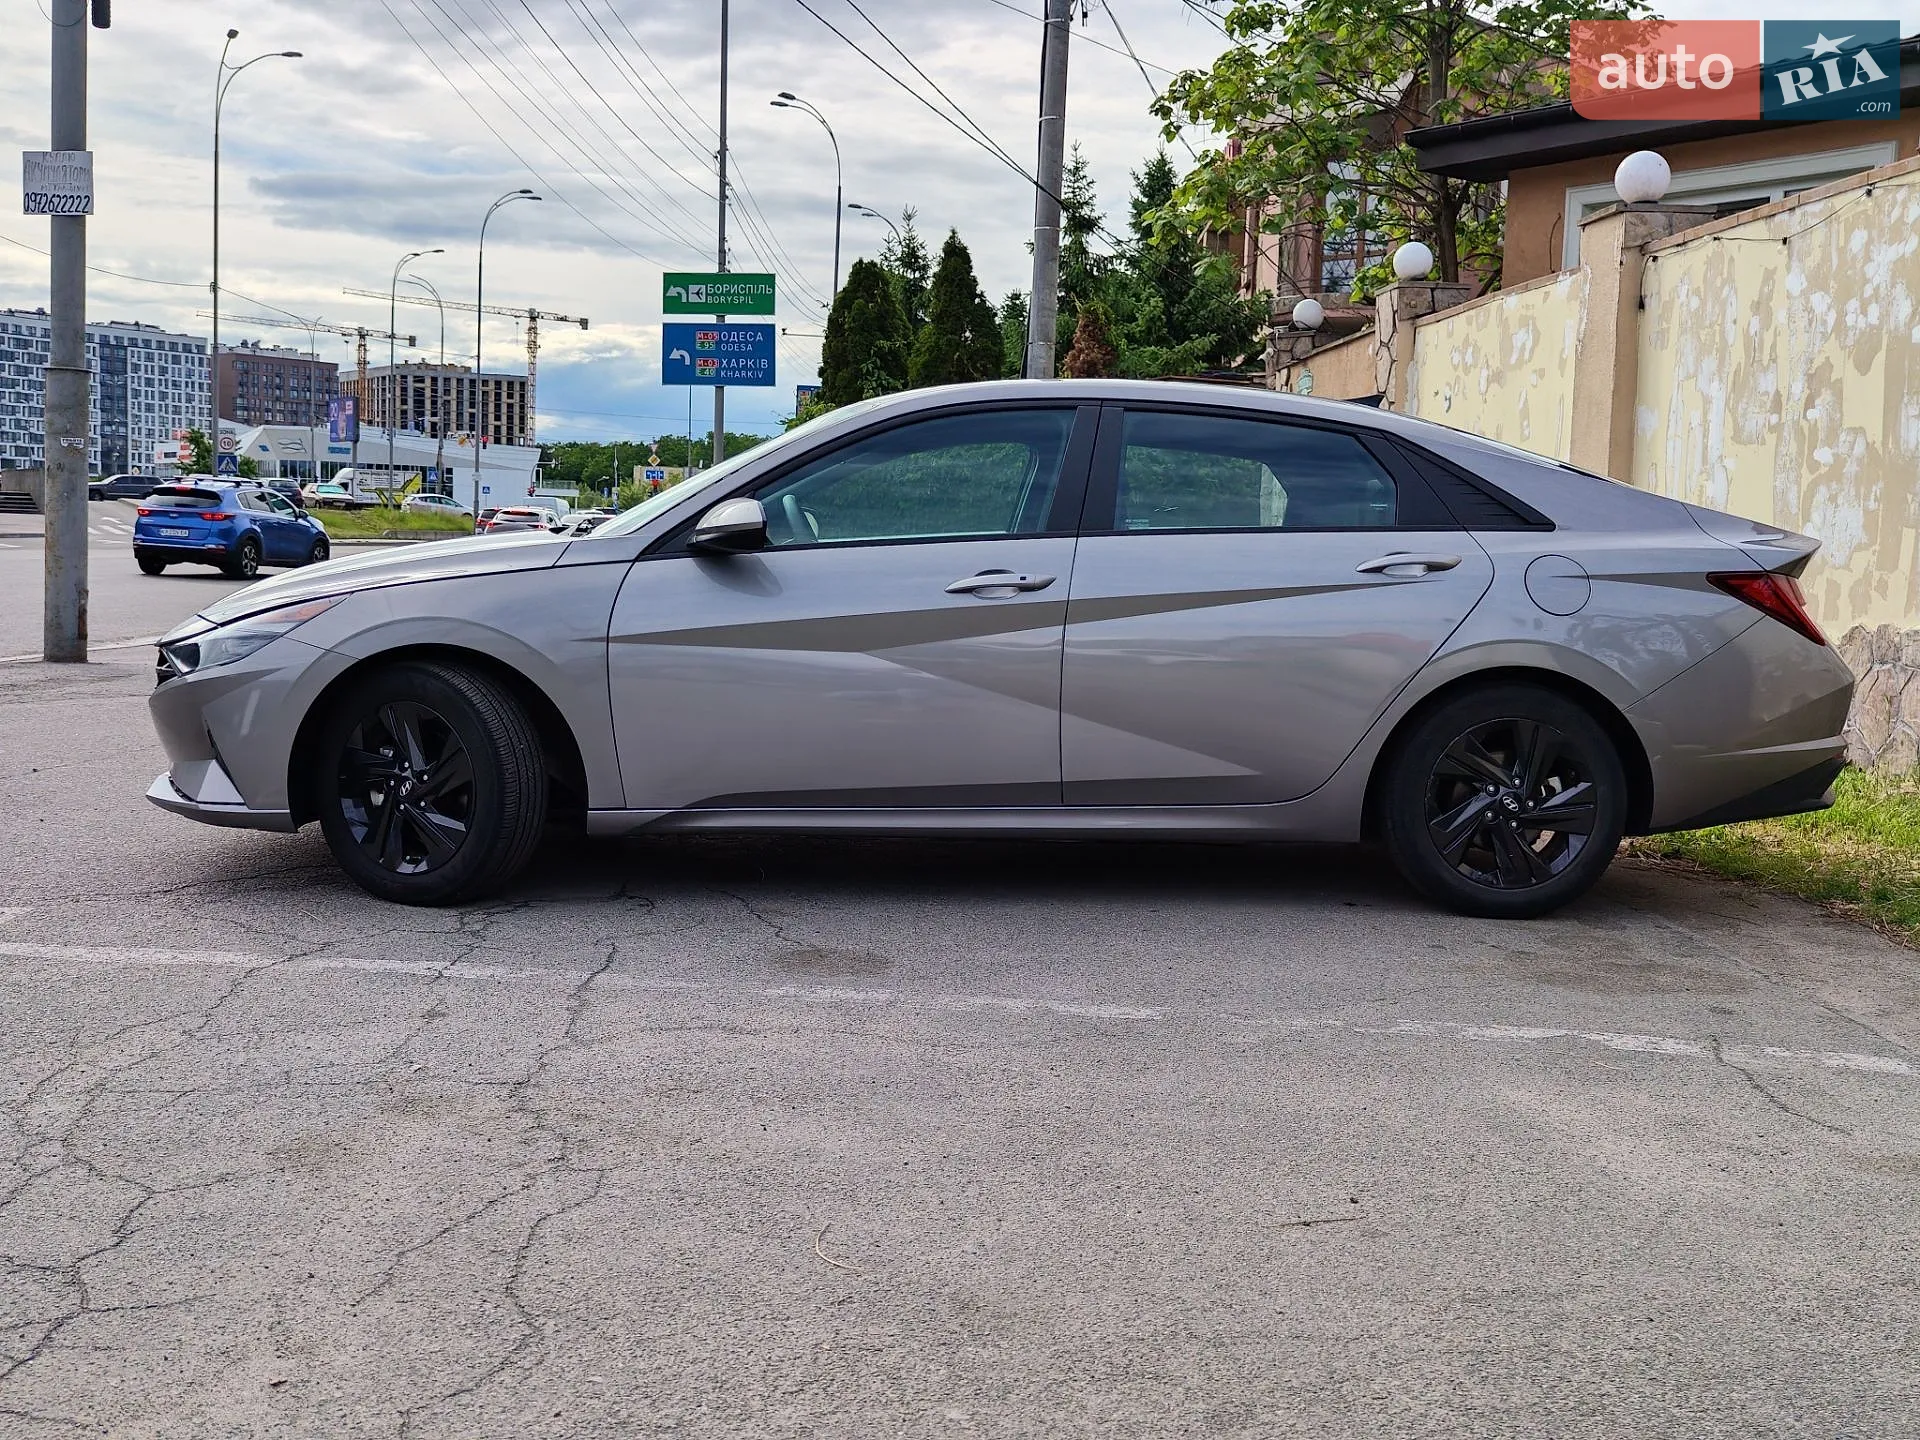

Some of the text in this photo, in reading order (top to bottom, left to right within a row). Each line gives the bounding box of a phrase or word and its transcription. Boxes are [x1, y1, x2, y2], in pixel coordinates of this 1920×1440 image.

[24, 191, 91, 213] 0972622222
[707, 284, 773, 294] БОРИСПІЛЬ
[707, 296, 754, 304] BORYSPIL
[721, 332, 764, 342] ОДЕСА
[721, 343, 753, 351] ODESA
[721, 358, 769, 368] ХАРКІВ
[721, 370, 764, 378] KHARKIV
